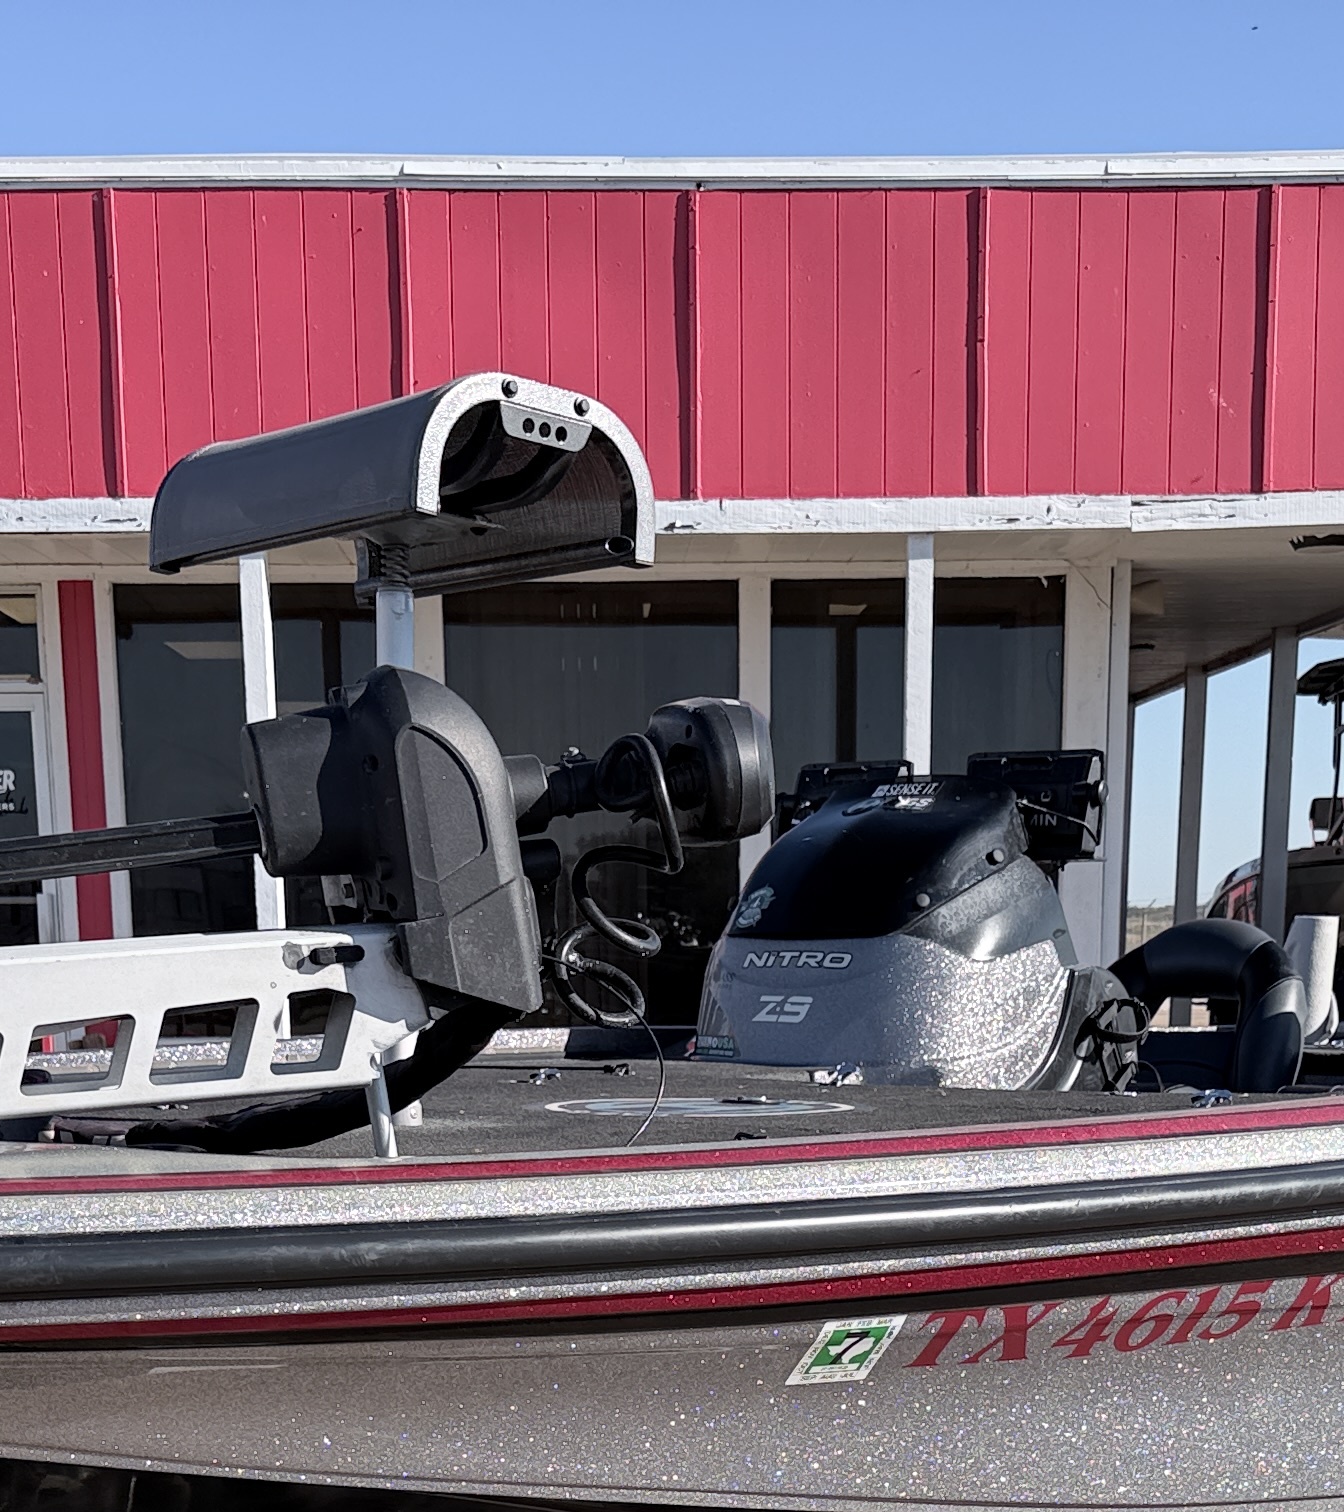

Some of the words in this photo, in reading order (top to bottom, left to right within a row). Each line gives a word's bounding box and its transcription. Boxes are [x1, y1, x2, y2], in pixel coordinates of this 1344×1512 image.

[741, 951, 854, 969] NITRO
[751, 995, 814, 1024] Z9
[902, 1302, 1061, 1369] TX
[1051, 1279, 1277, 1360] 4615
[829, 1330, 871, 1365] 7
